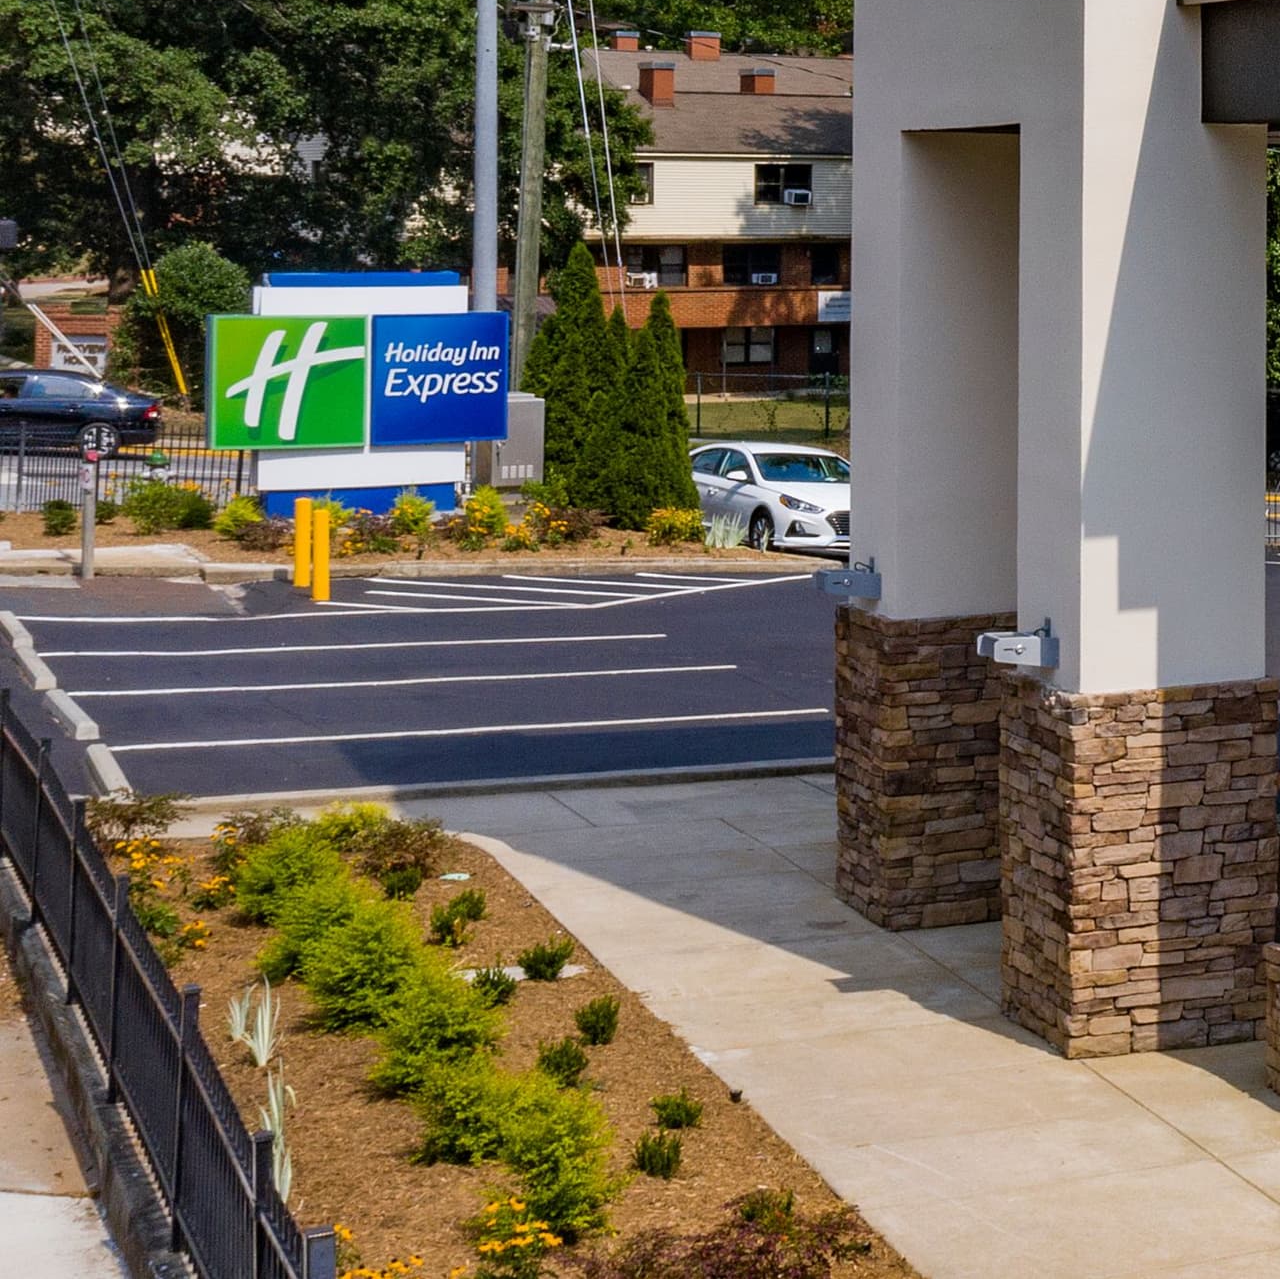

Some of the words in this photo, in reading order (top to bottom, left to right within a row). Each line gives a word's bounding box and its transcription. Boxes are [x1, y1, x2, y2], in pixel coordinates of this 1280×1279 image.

[384, 341, 468, 366] Holiday
[468, 340, 500, 361] Inn
[384, 368, 500, 403] Express
